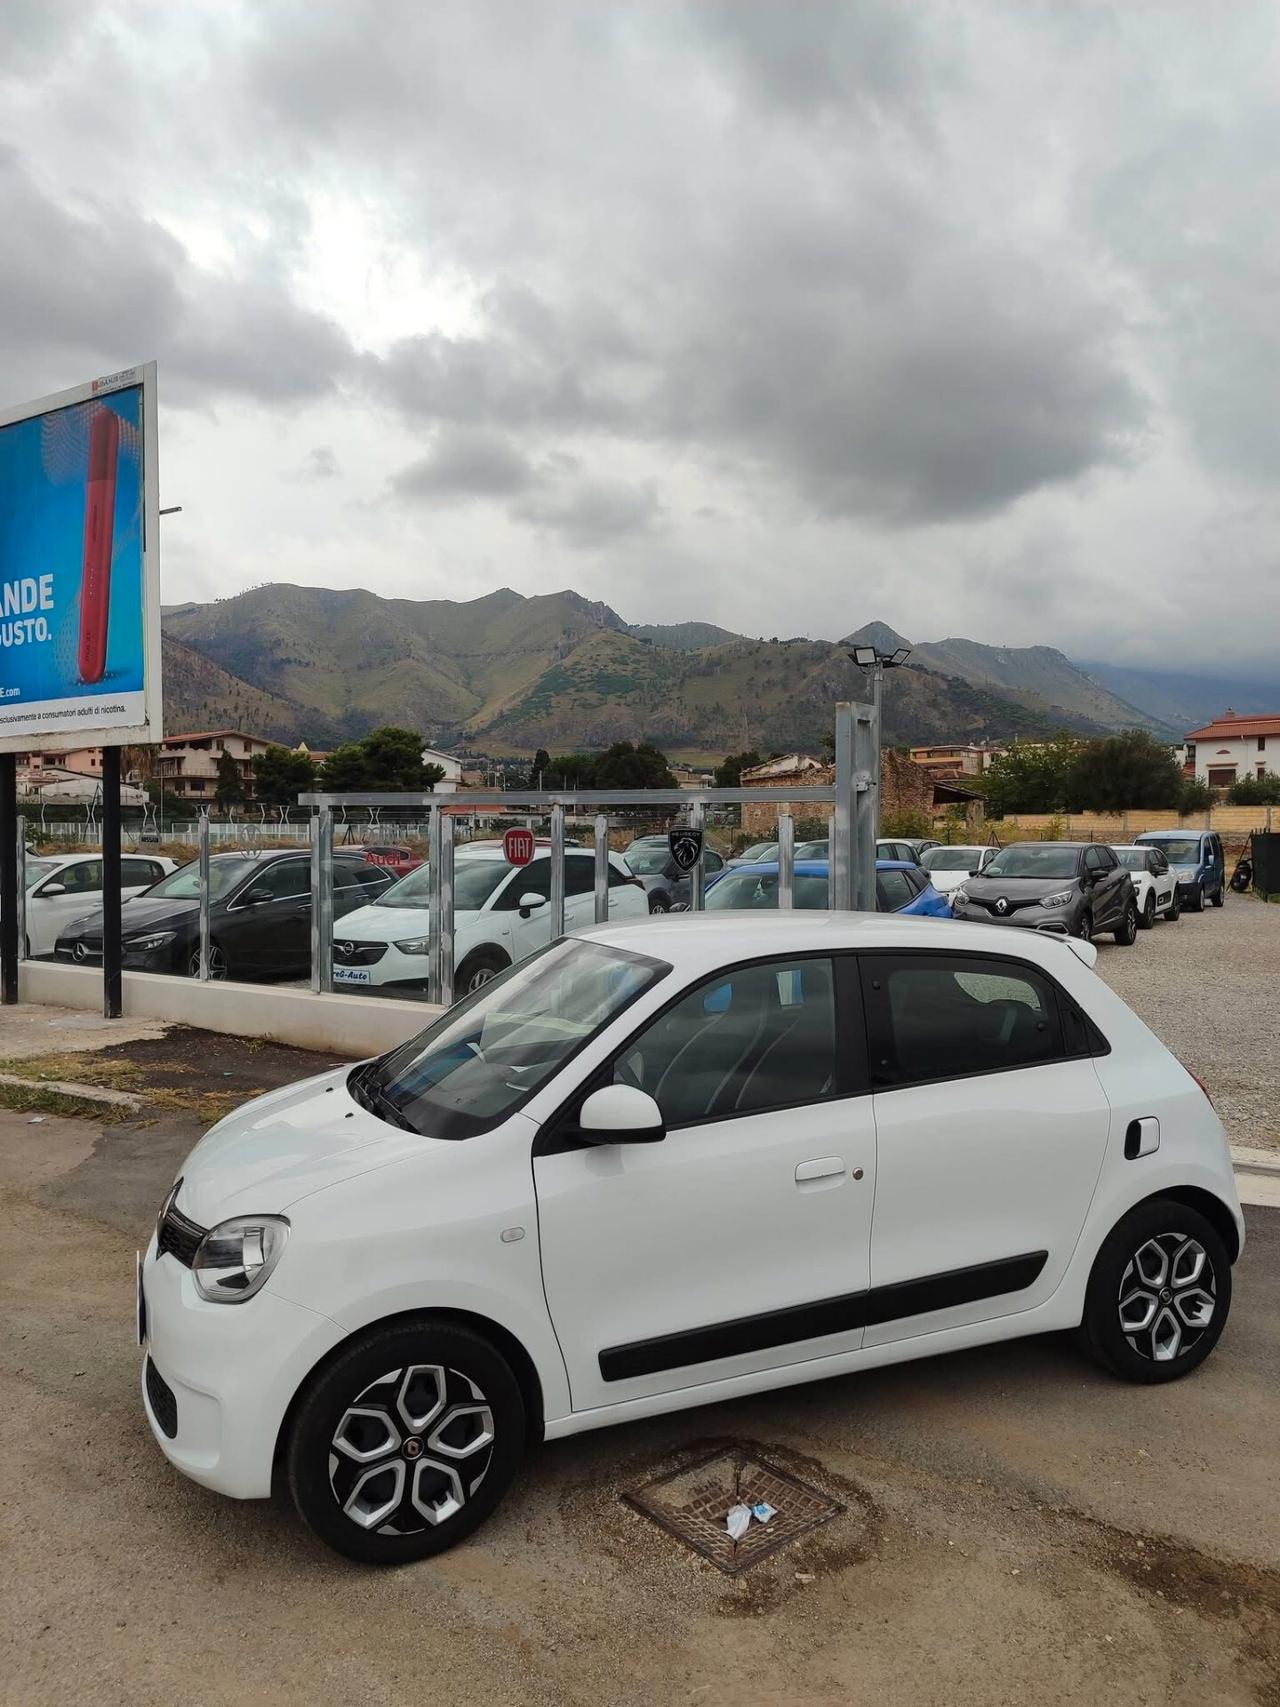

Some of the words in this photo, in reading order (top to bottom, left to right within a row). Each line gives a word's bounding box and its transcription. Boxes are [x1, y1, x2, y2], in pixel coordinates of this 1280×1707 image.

[0, 573, 54, 617] NDE
[0, 617, 52, 648] USTO.
[42, 708, 76, 720] consumatori
[77, 706, 93, 717] adulti
[101, 704, 126, 714] nicotina.
[367, 852, 400, 866] Audi
[508, 837, 532, 859] FIAT
